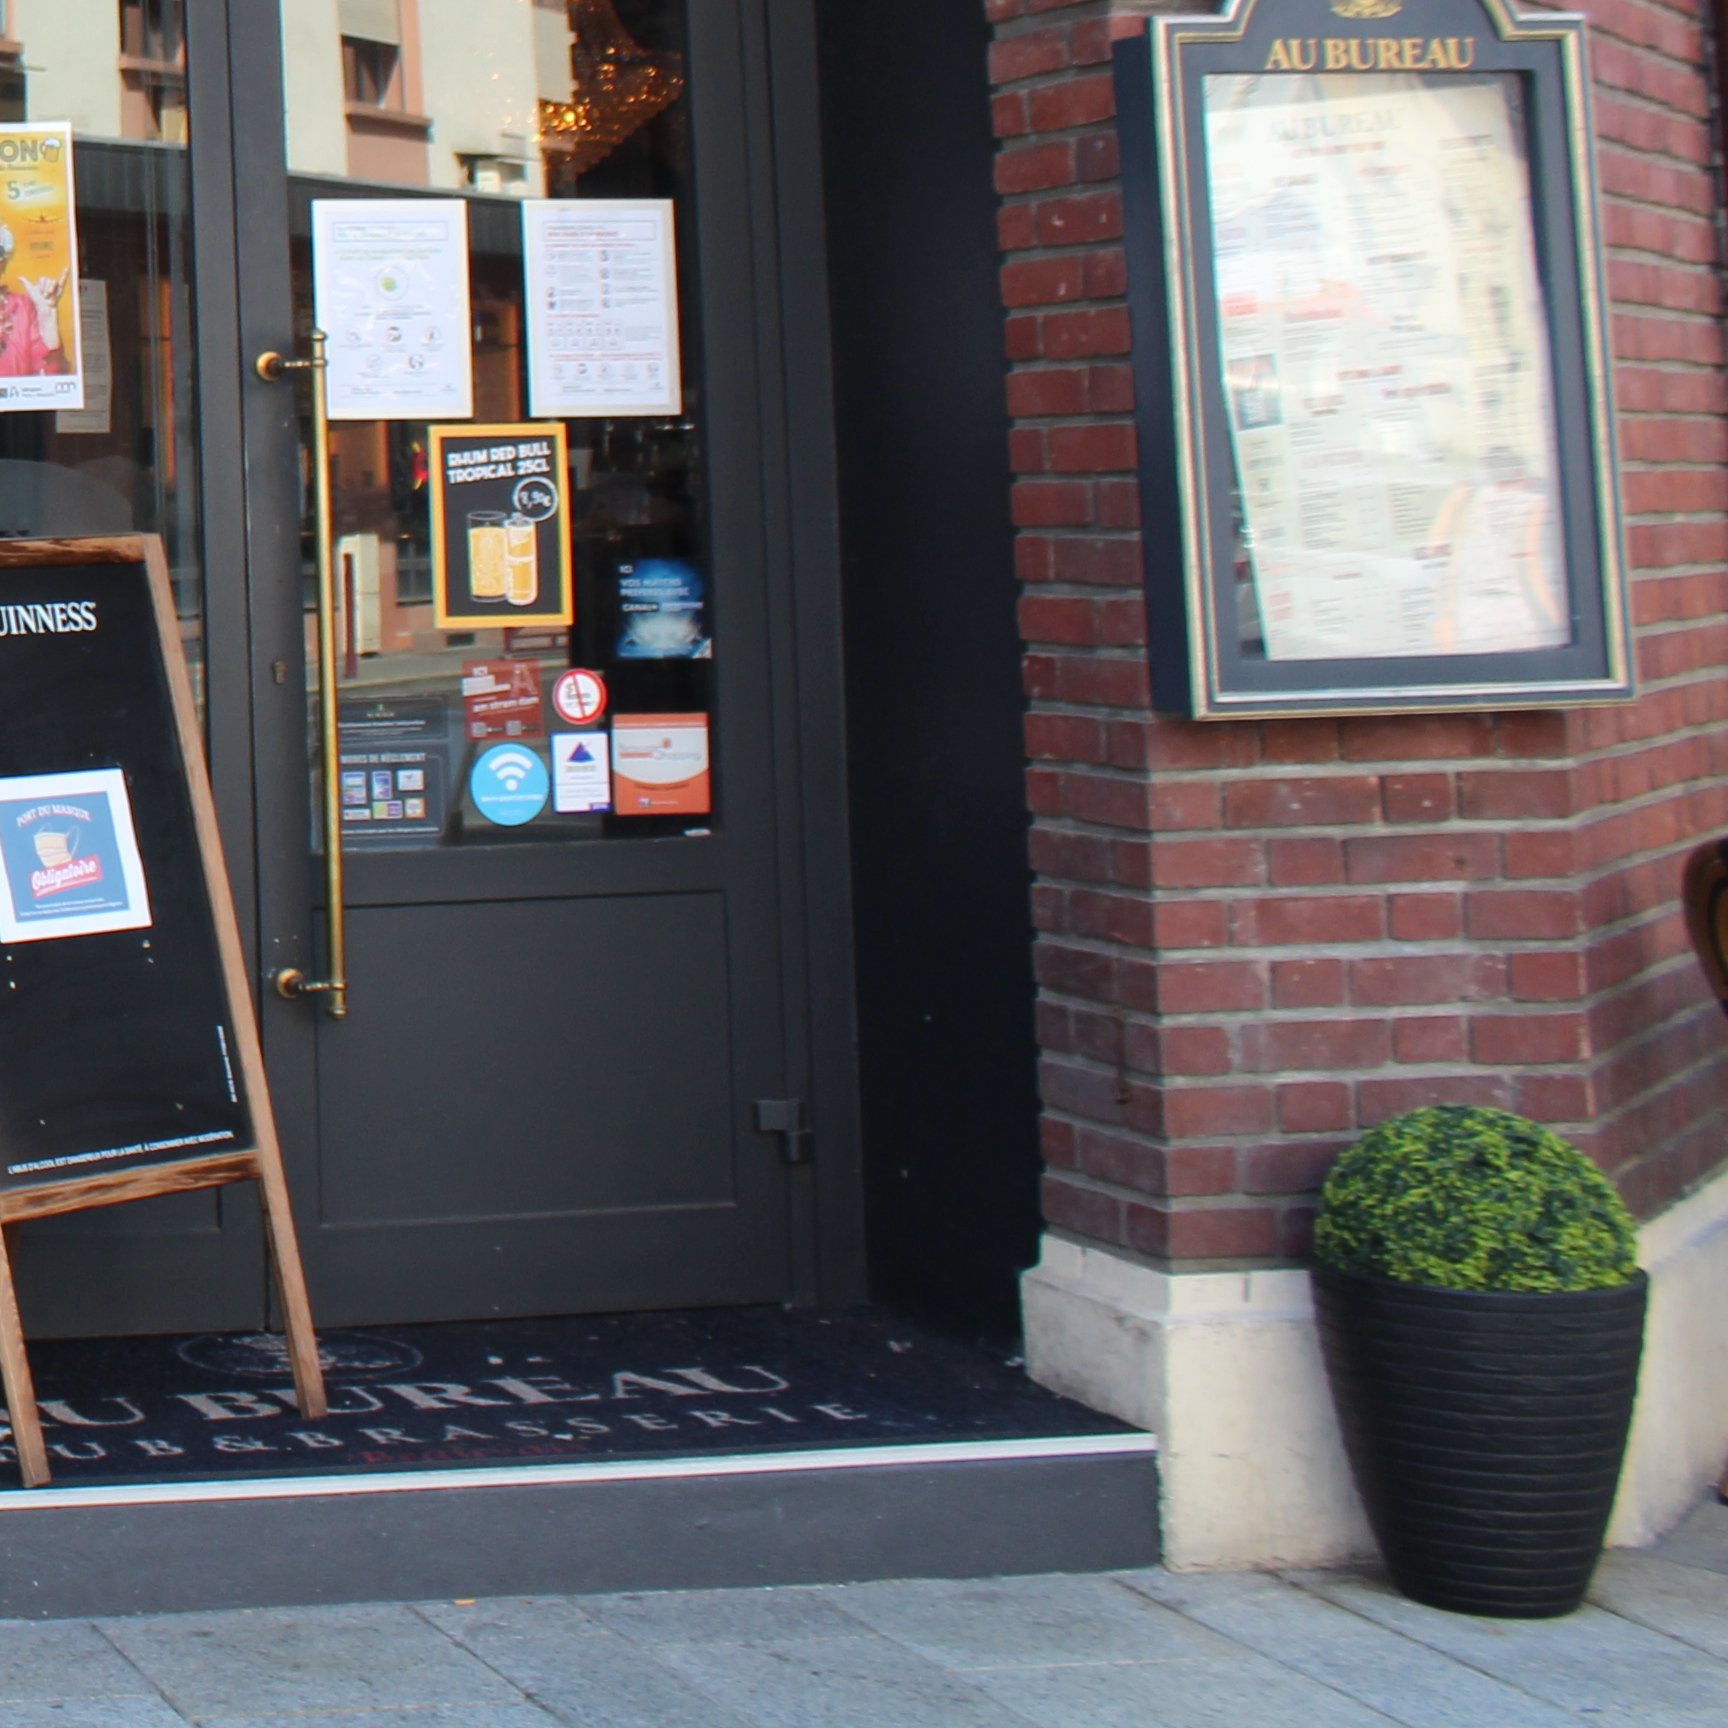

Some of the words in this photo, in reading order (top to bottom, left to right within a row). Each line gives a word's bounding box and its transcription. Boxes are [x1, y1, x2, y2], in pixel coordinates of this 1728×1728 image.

[1263, 37, 1321, 71] AU
[1322, 36, 1476, 71] BUREAU
[6, 180, 22, 200] 5
[489, 444, 517, 462] RED
[517, 441, 552, 459] BULL
[446, 462, 516, 484] TROPICAL
[168, 1365, 789, 1422] BUREAU
[212, 1433, 279, 1453] &
[285, 1401, 868, 1450] BRASSERIE
